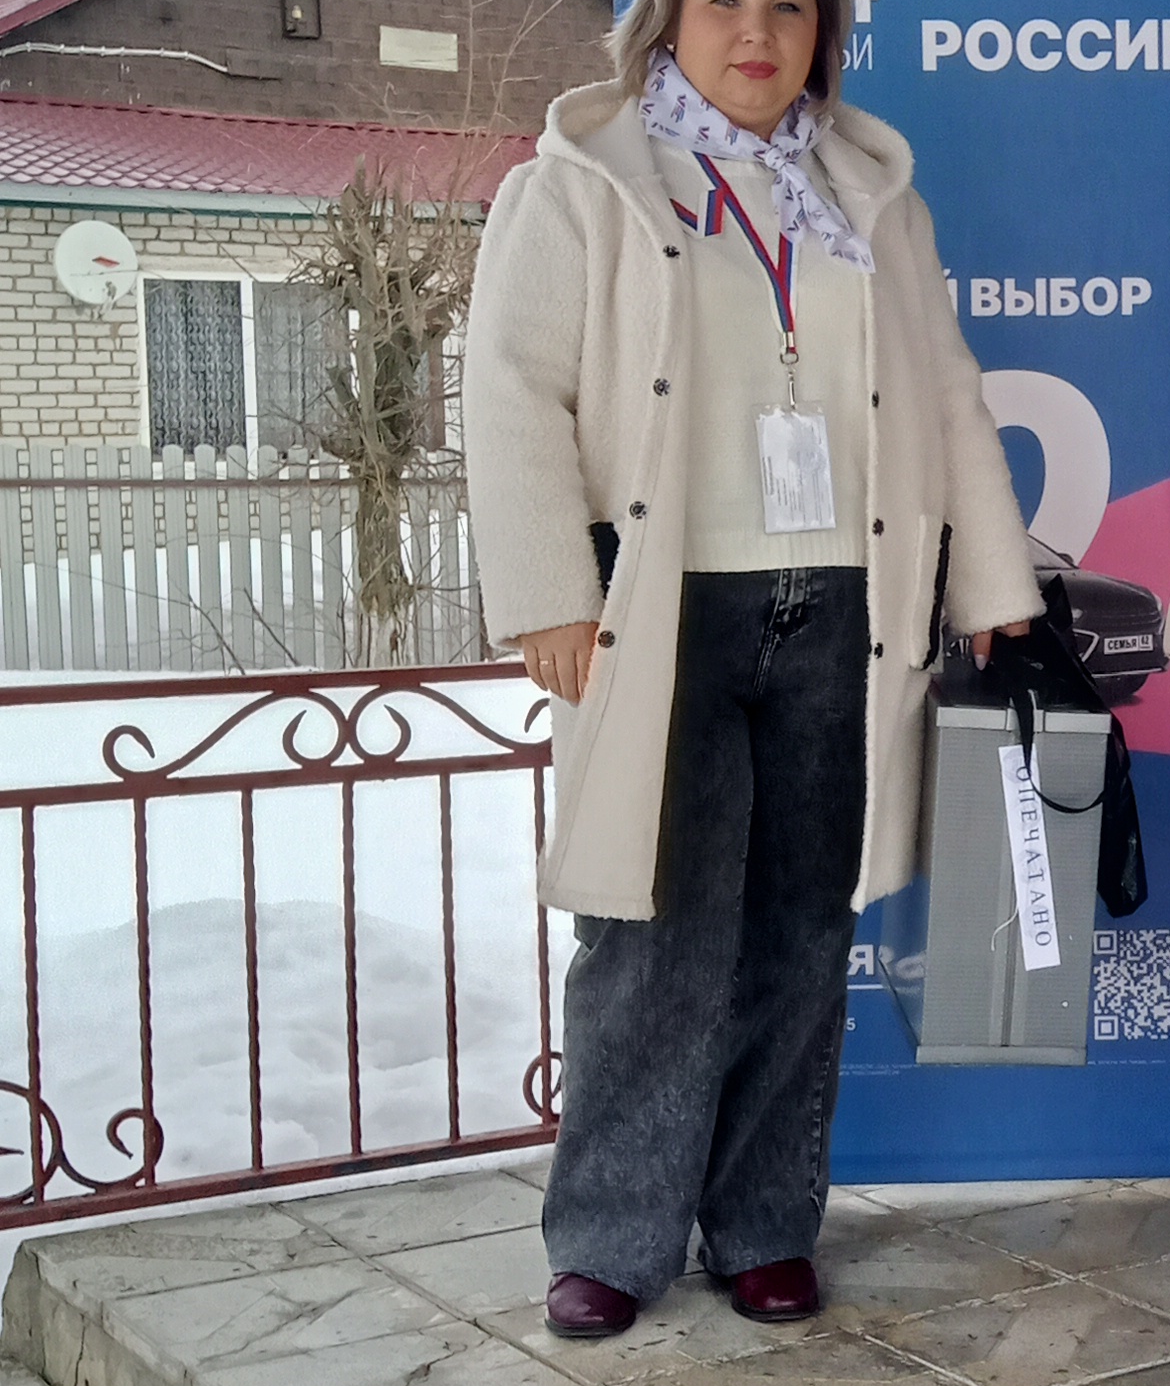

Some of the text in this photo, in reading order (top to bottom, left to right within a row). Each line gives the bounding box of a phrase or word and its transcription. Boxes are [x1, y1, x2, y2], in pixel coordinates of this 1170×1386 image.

[970, 276, 1152, 317] ВЫБОР
[1107, 638, 1138, 651] СЕМЬЯ
[1015, 765, 1053, 947] ОПЕЧАТАНО
